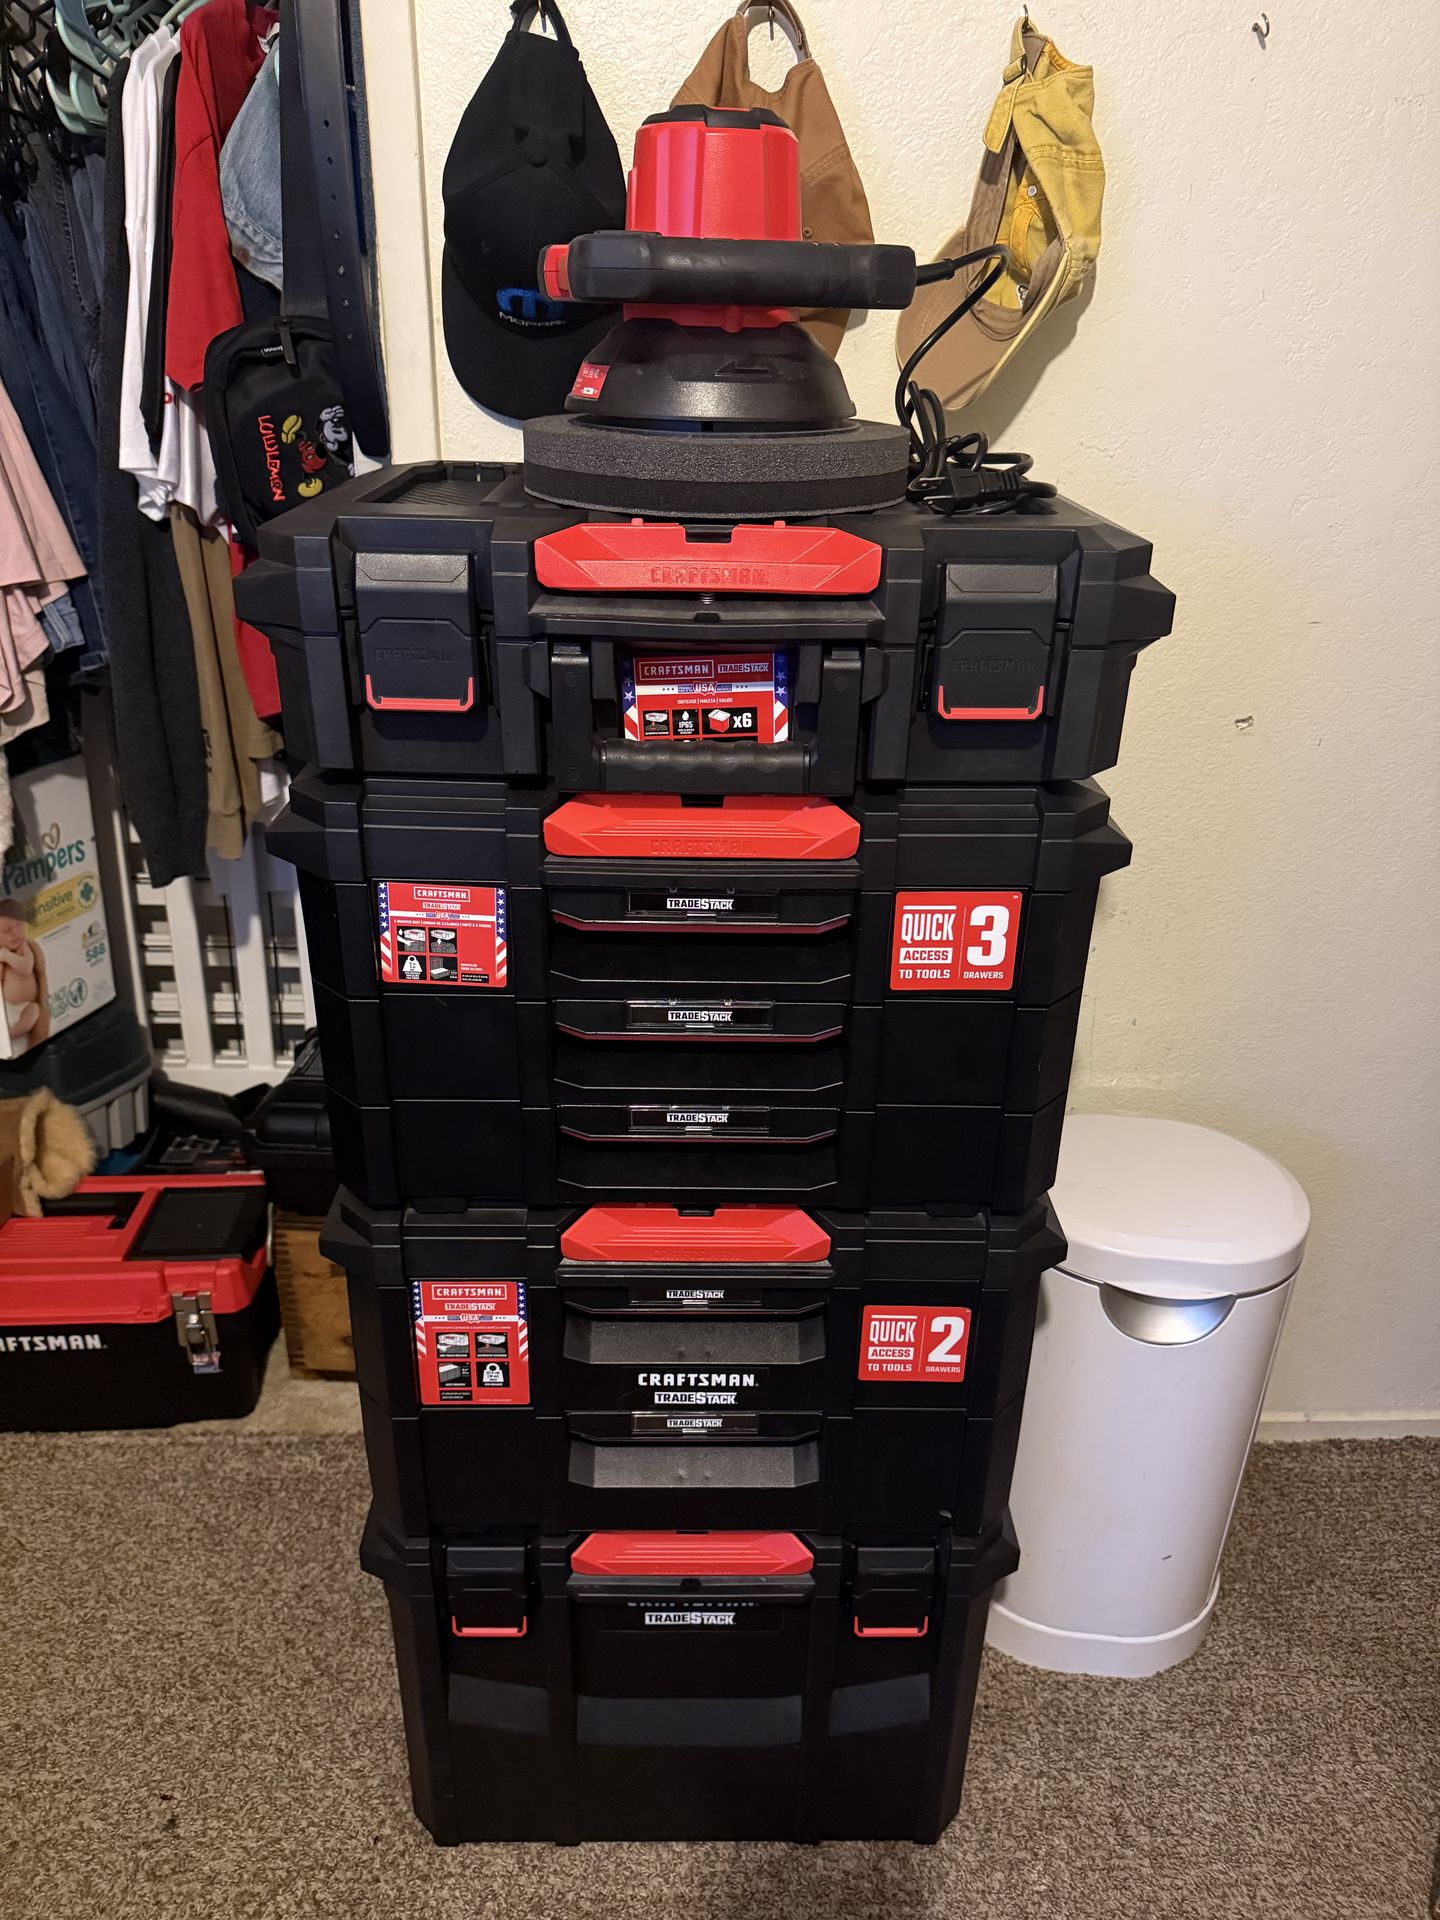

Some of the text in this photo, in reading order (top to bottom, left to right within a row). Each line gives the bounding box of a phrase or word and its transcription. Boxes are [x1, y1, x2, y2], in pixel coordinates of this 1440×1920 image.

[650, 566, 765, 584] CRAFTSMAN
[644, 664, 709, 676] CRAFTSMAN
[695, 683, 715, 692] USA
[732, 712, 753, 729] x6
[3, 839, 86, 896] Pampers
[417, 889, 467, 899] CRAFTSMAN
[666, 898, 735, 911] TRADESTACK
[901, 913, 956, 944] QUICK
[966, 905, 1010, 967] 3
[903, 949, 949, 961] ACCESS
[899, 968, 951, 979] TO TOOLS
[963, 971, 1004, 979] DRAWERS
[667, 1010, 734, 1022] TRADESTACK
[666, 1112, 730, 1123] TRADESTACK
[436, 1288, 502, 1297] CRAFTSMAN
[666, 1289, 725, 1299] TRADESTACK
[869, 1320, 917, 1344] QUICK
[927, 1316, 965, 1363] 2
[871, 1348, 911, 1358] ACCESS
[867, 1363, 913, 1372] TO TOOLS
[638, 1373, 755, 1387] CRAFTSMAN
[654, 1391, 738, 1404] TRADESTACK
[666, 1418, 724, 1428] TRADESTACK
[644, 1611, 736, 1625] TRADESTACK
